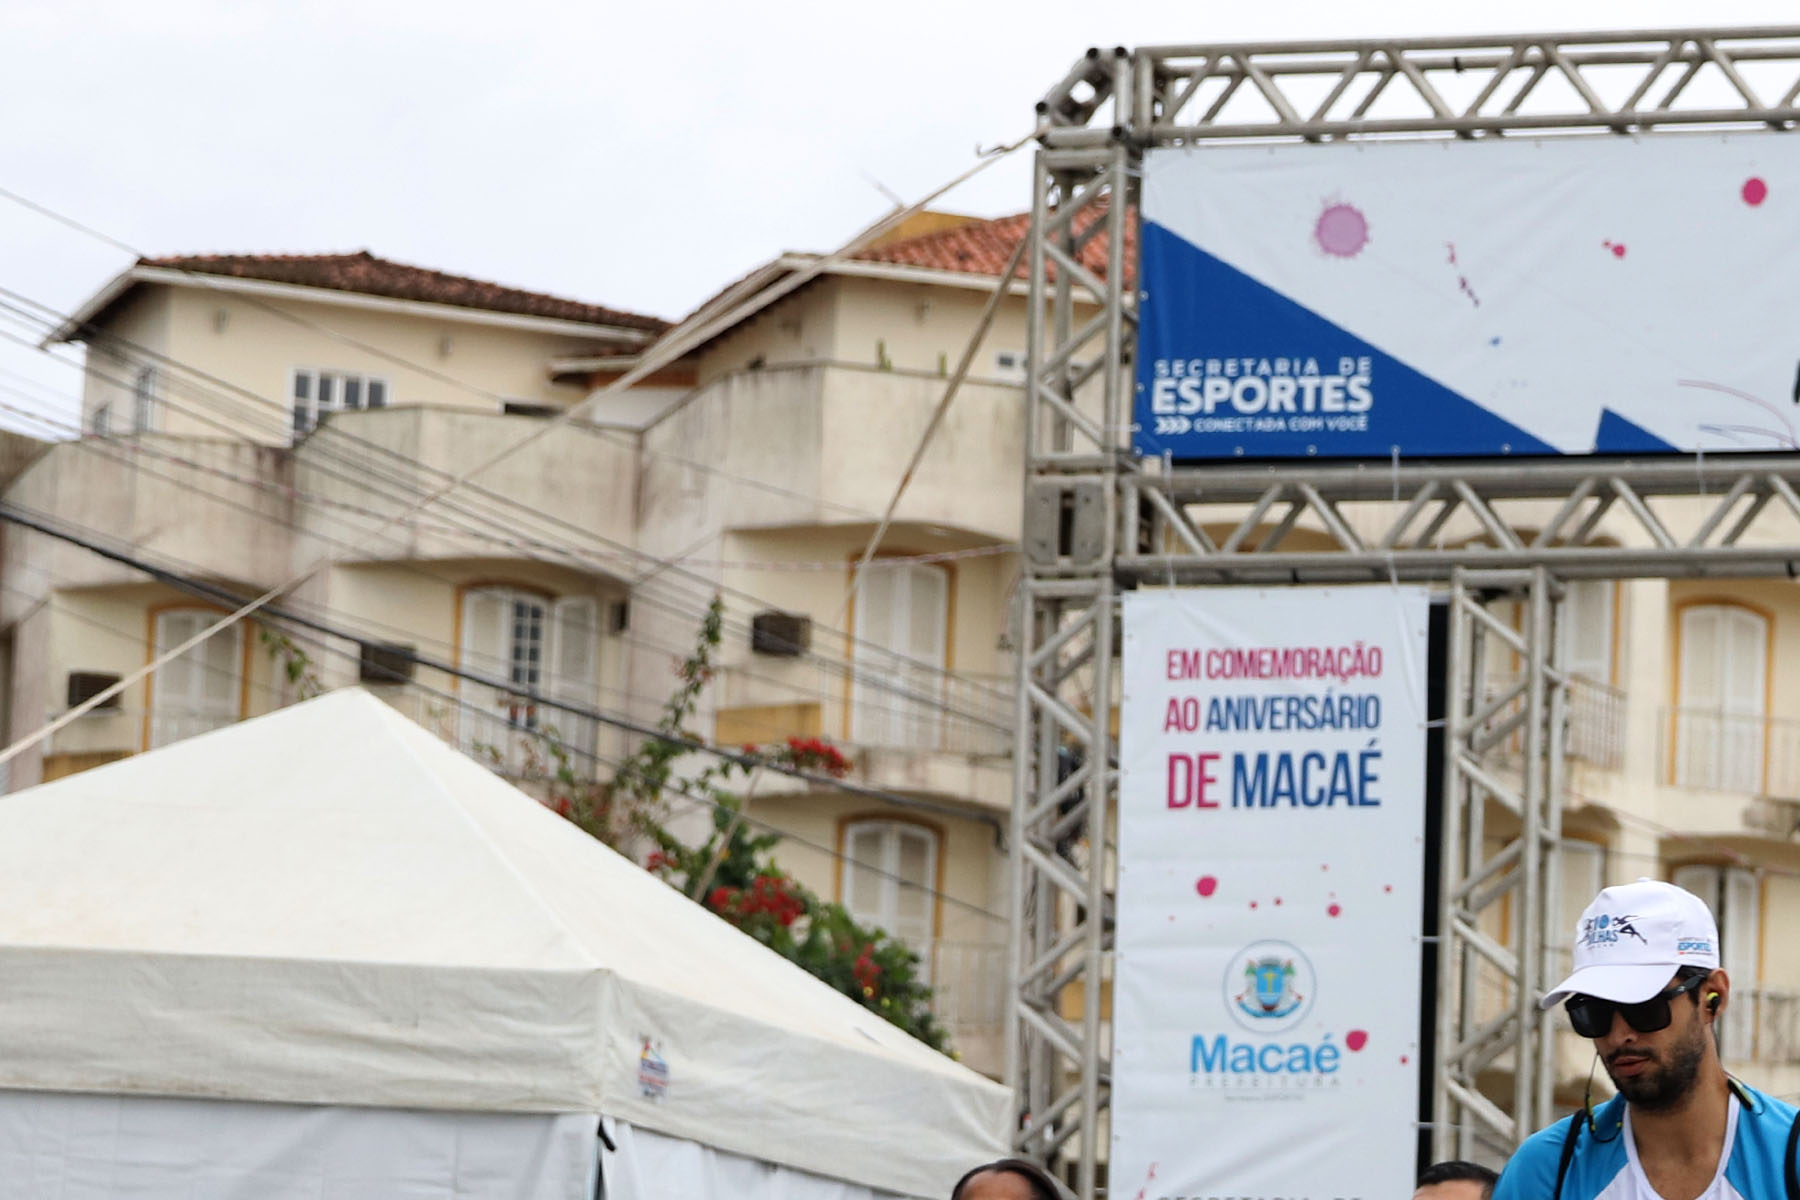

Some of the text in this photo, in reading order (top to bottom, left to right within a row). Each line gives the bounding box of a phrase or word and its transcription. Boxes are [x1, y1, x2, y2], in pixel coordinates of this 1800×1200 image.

[1154, 356, 1372, 378] SECRETARIA DE
[1152, 376, 1373, 415] ESPORTES
[1194, 412, 1369, 433] CONECTADA COM VOCÊ
[1167, 641, 1383, 683] EM COMEMORAÇÃO
[1164, 687, 1381, 733] AO ANIVERSÁRIO
[1167, 739, 1382, 809] DE MACAÉ
[1191, 1034, 1340, 1074] Macaé
